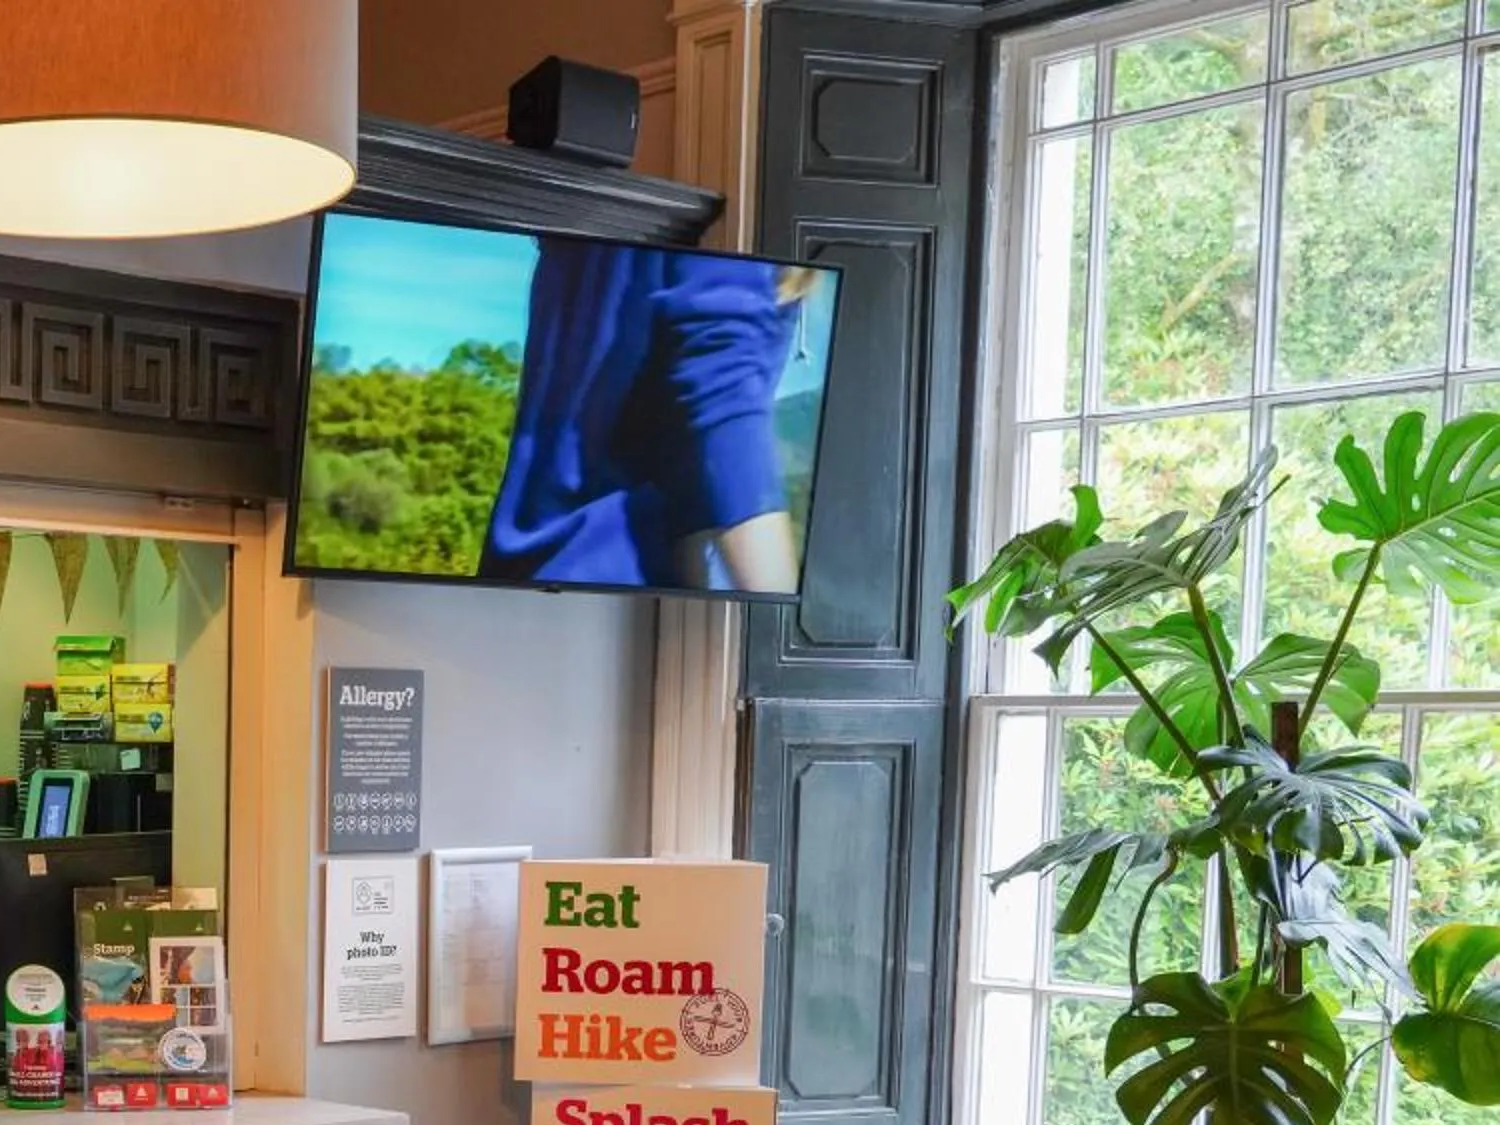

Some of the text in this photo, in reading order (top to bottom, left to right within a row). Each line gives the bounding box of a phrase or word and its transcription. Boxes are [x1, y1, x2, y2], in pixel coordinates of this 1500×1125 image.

[340, 685, 415, 711] Allergy?
[543, 881, 641, 928] Eat
[93, 943, 135, 956] Stamp
[360, 931, 385, 944] Why
[347, 945, 397, 960] photo ID?
[541, 947, 714, 995] Roam
[537, 1013, 677, 1062] Hike
